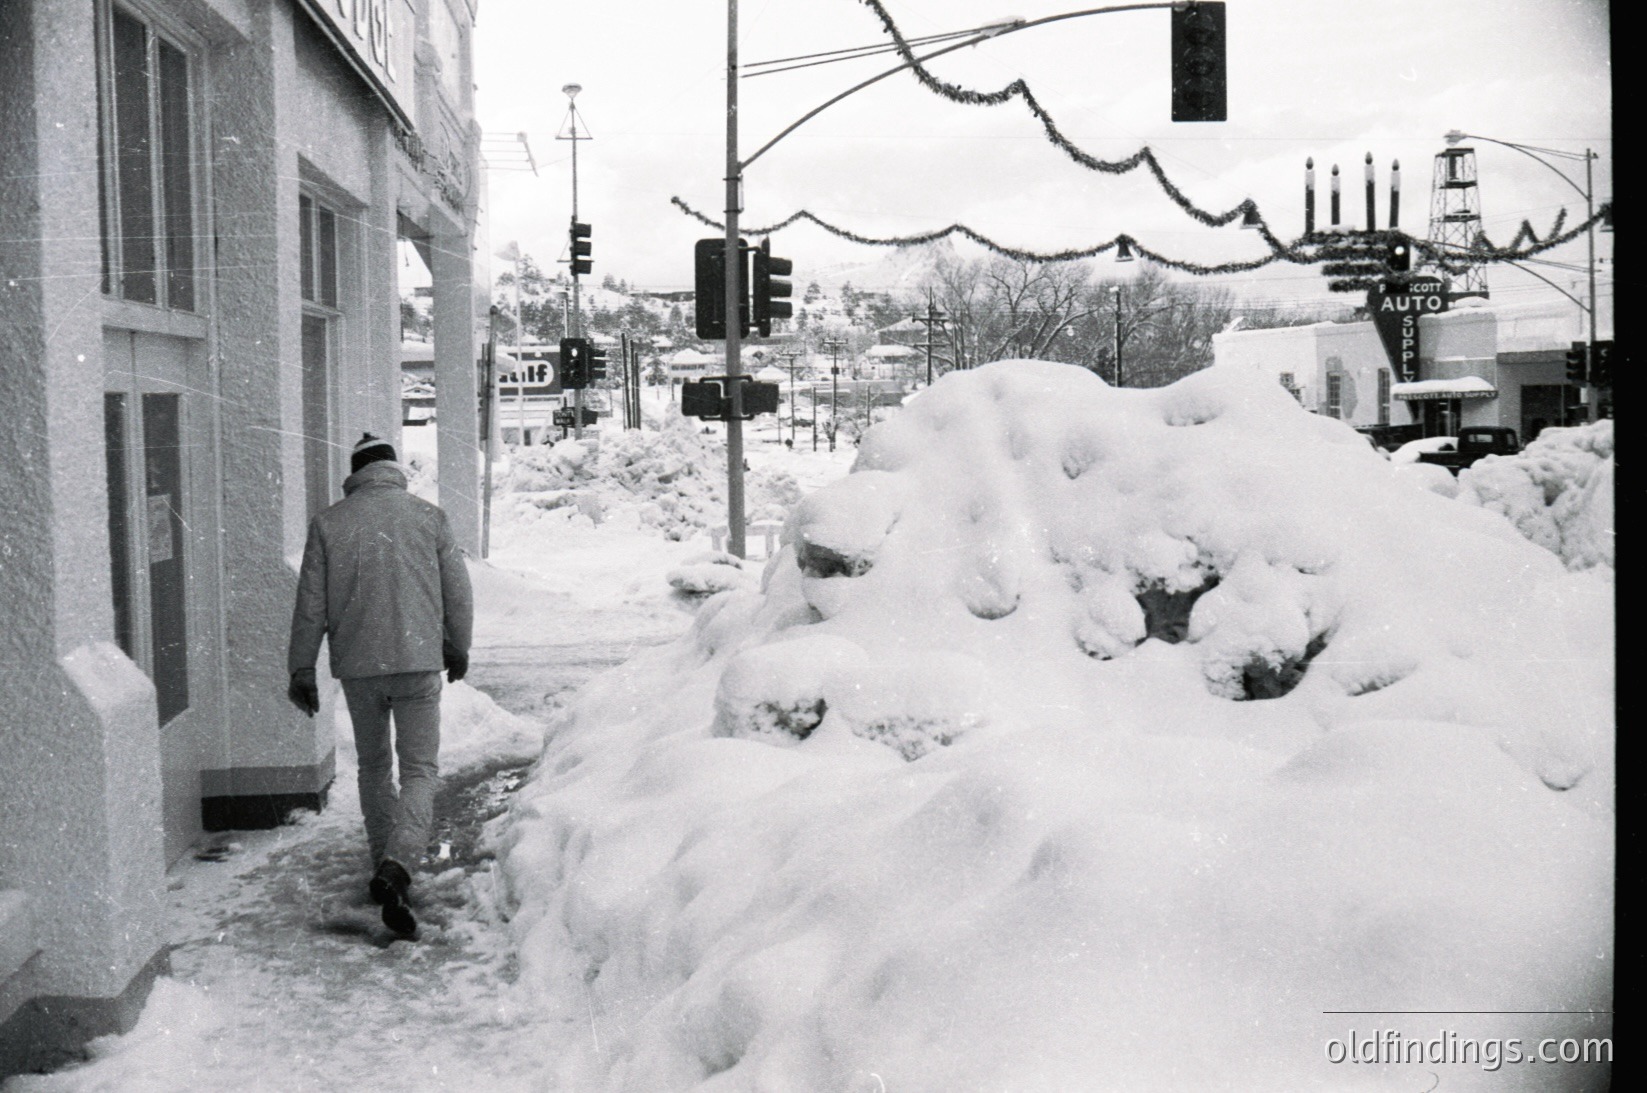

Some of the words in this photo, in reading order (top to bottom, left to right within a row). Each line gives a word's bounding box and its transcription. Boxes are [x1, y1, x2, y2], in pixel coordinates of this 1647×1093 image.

[1380, 295, 1442, 311] AUTO
[1402, 315, 1415, 382] SUPPLY
[1398, 392, 1439, 400] PRESCOTT
